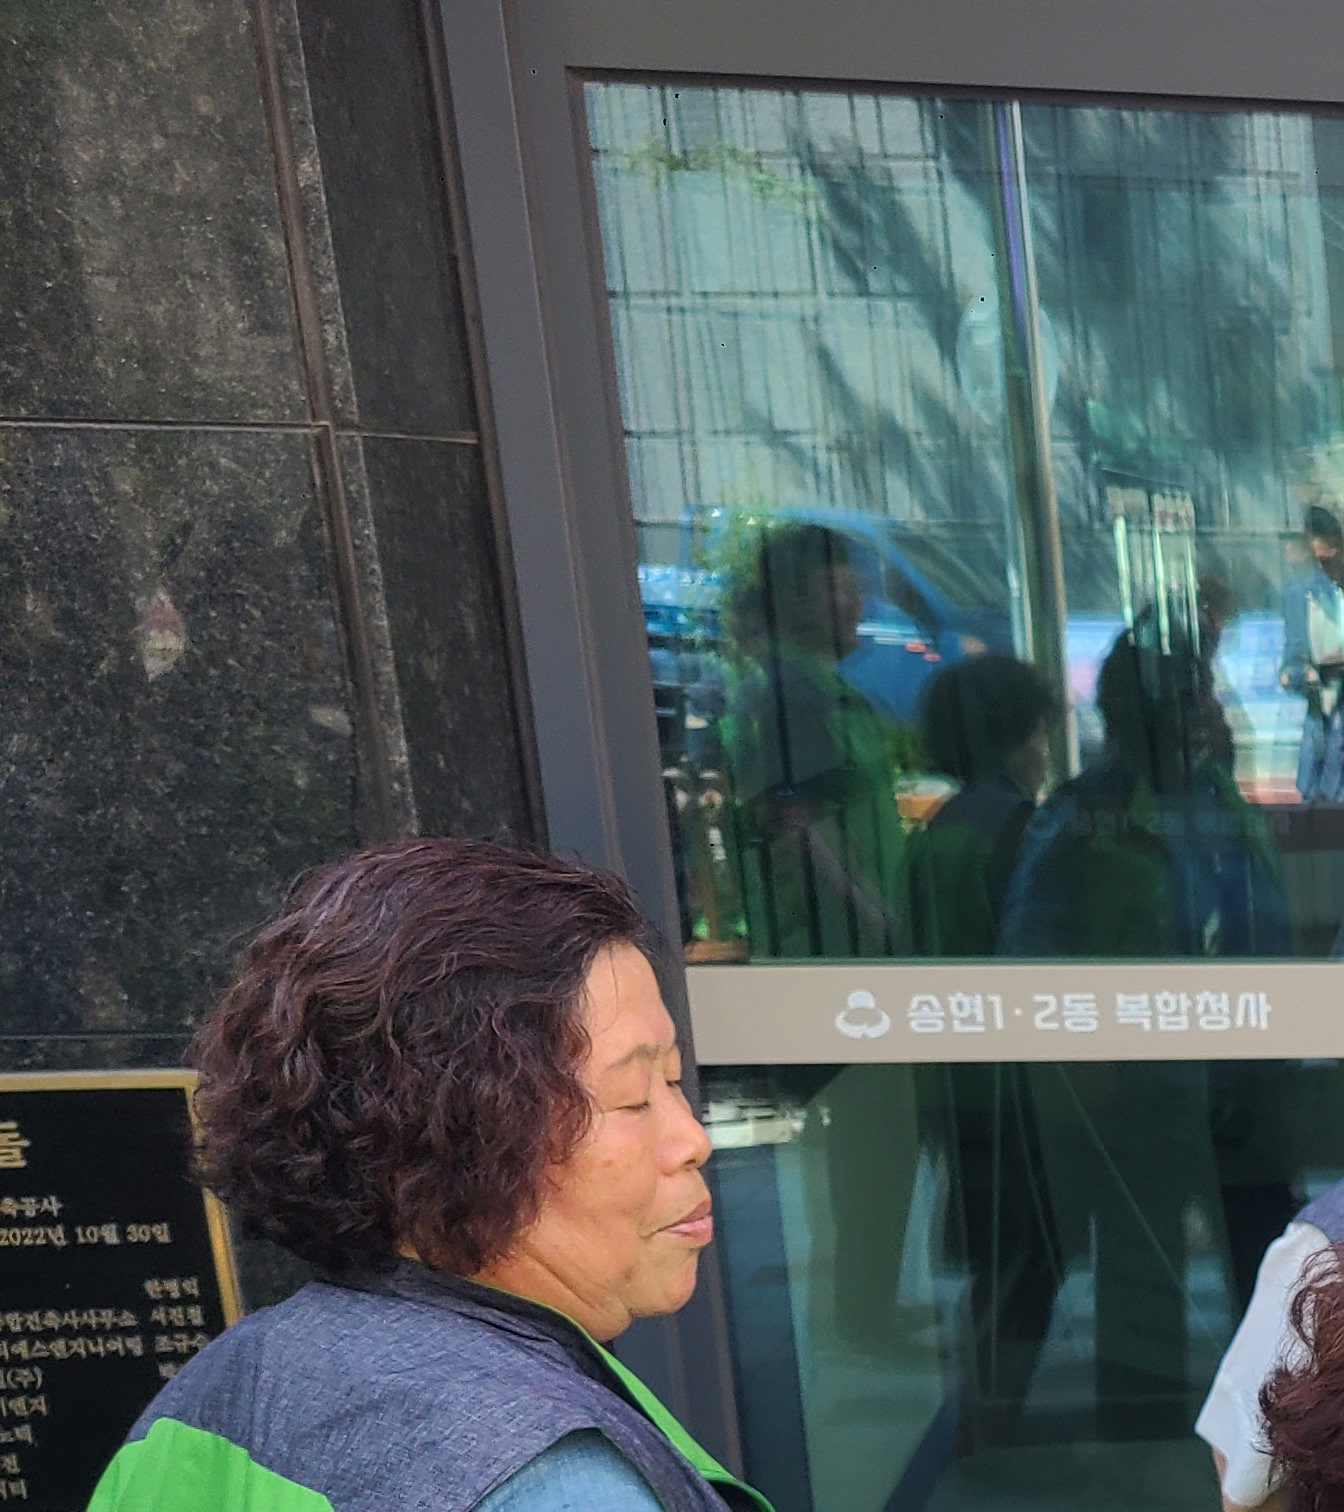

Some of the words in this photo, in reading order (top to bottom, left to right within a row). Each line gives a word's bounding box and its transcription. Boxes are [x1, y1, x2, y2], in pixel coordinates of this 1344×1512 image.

[1116, 989, 1272, 1031] 복합청사
[75, 1223, 120, 1245] 10월
[126, 1222, 172, 1244] 30일
